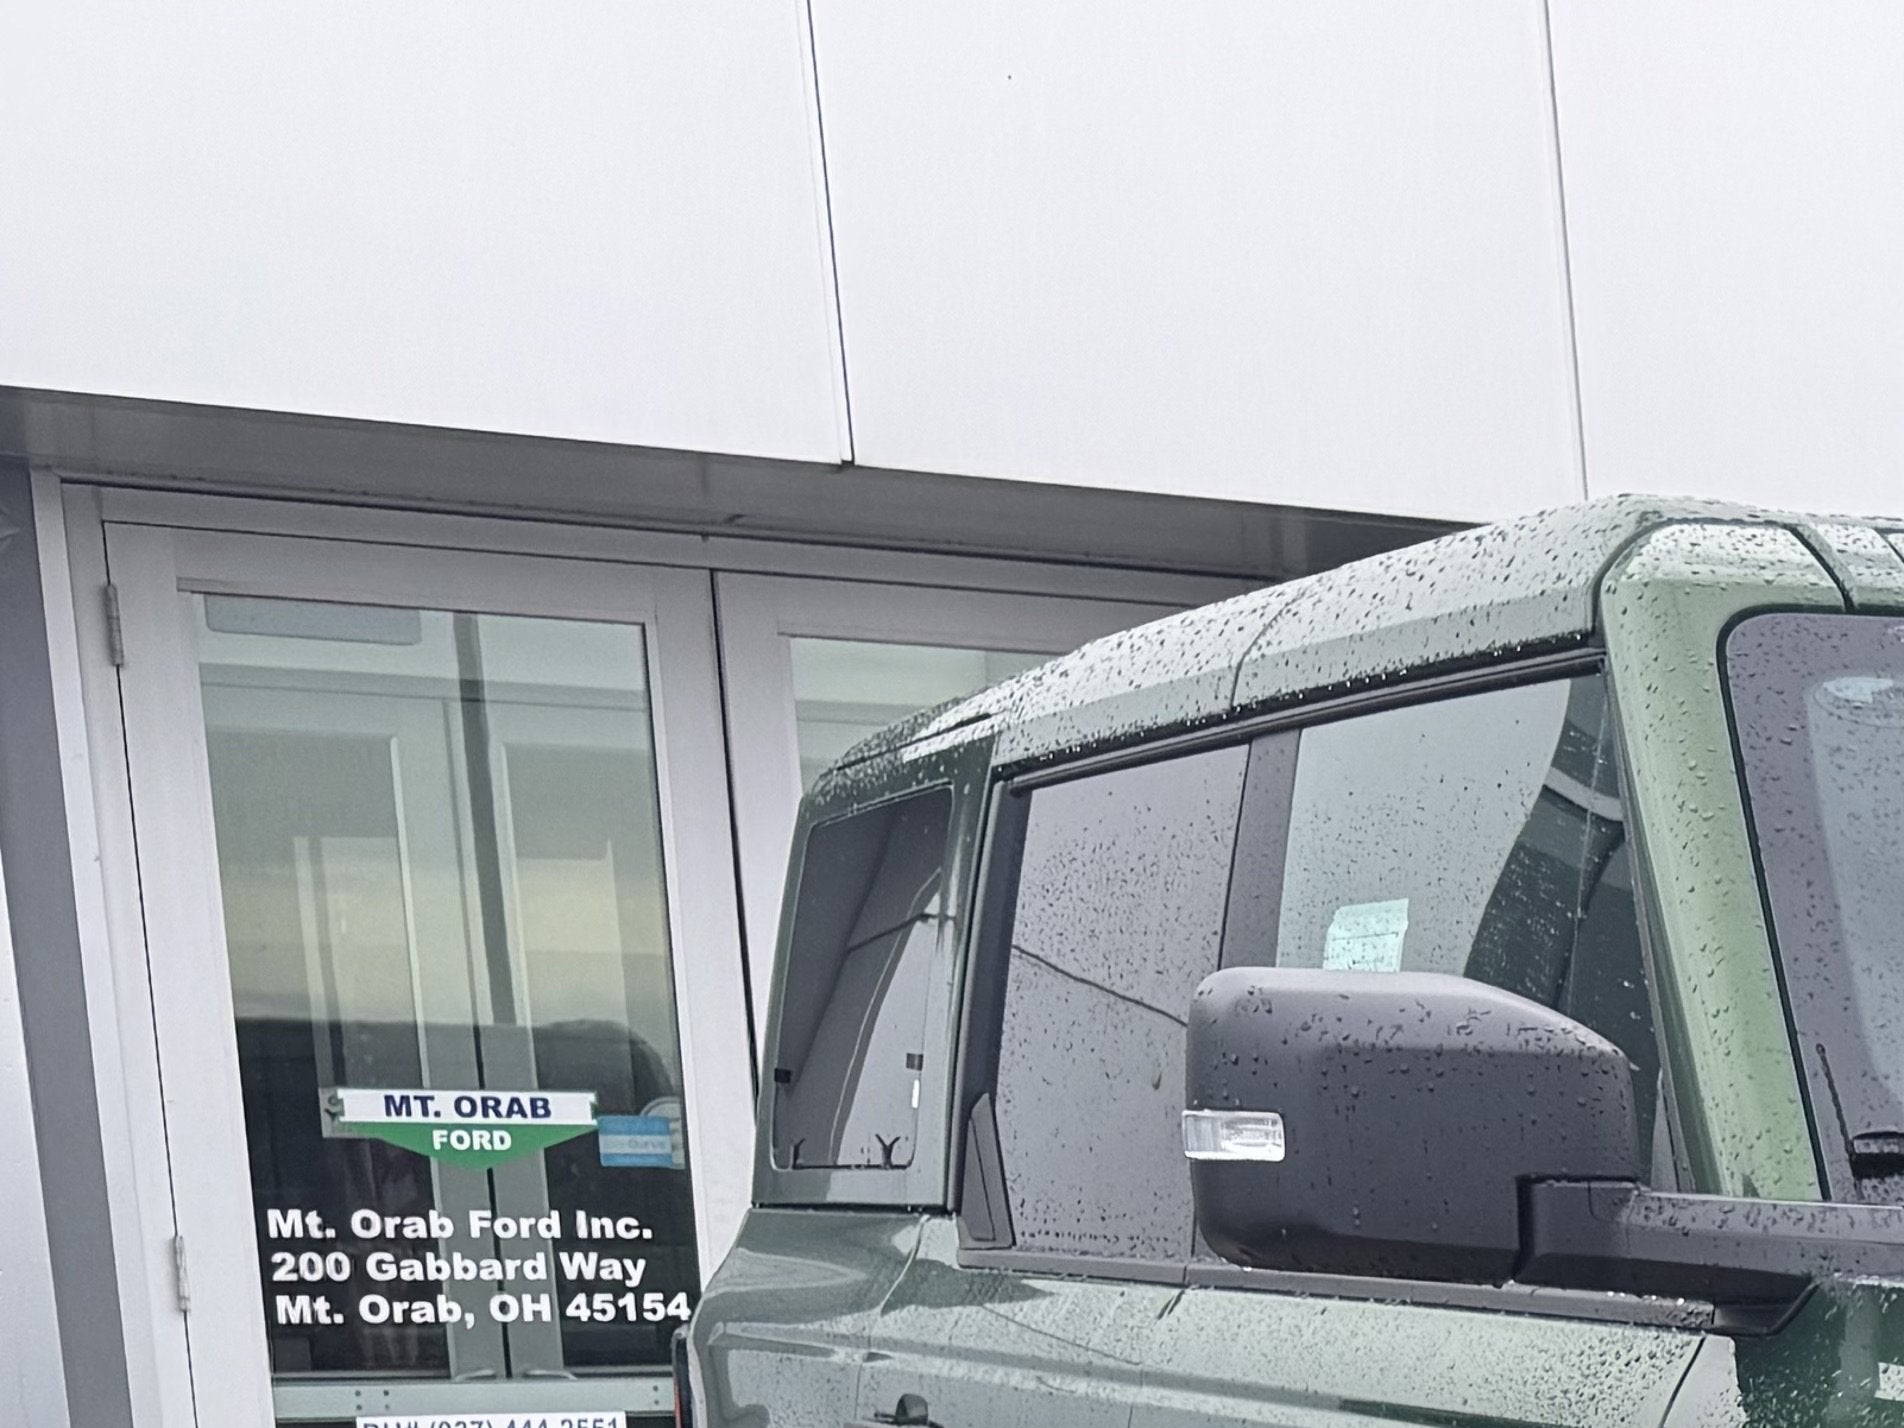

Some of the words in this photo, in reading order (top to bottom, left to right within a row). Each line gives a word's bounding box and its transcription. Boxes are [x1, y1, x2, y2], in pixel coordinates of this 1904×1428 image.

[383, 1095, 442, 1119] MT.
[453, 1094, 552, 1119] ORAB
[432, 1129, 512, 1151] FORD
[267, 1209, 336, 1239] Mt.
[350, 1209, 455, 1240] Orab
[469, 1209, 561, 1239] Ford
[575, 1209, 653, 1240] Inc.
[271, 1252, 352, 1282] 200
[365, 1252, 547, 1281] Gabbard
[559, 1252, 647, 1287] Way
[276, 1295, 344, 1325] Mt.
[358, 1294, 475, 1329] Orab,
[489, 1294, 552, 1322] OH
[565, 1293, 691, 1321] 45154
